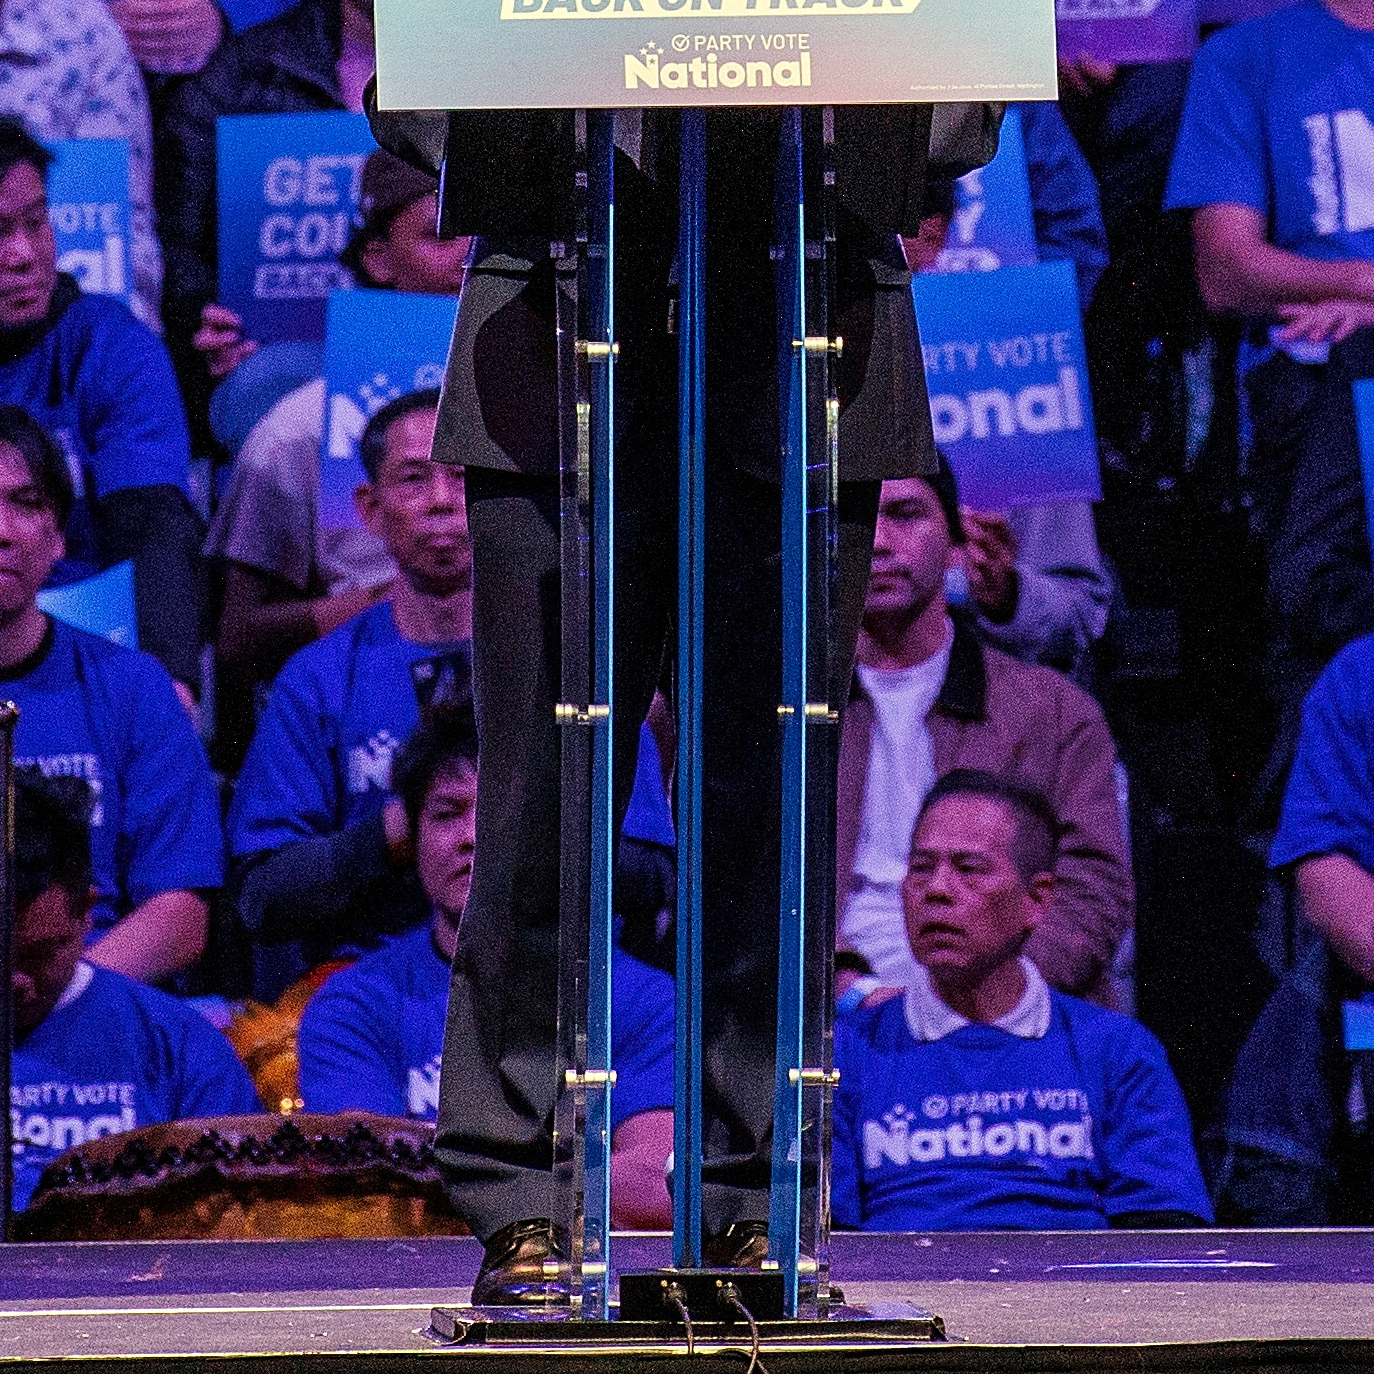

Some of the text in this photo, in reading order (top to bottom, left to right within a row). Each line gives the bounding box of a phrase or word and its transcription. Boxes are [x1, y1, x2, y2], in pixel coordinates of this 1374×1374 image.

[694, 33, 810, 52] PARTY VOTE
[624, 51, 811, 89] National
[49, 203, 120, 233] OTE
[922, 332, 1070, 374] RTY VOTE
[930, 365, 1083, 444] onal
[10, 1082, 136, 1107] ARTY VOTE
[950, 1090, 1028, 1117] PARTY
[862, 1113, 1095, 1169] National
